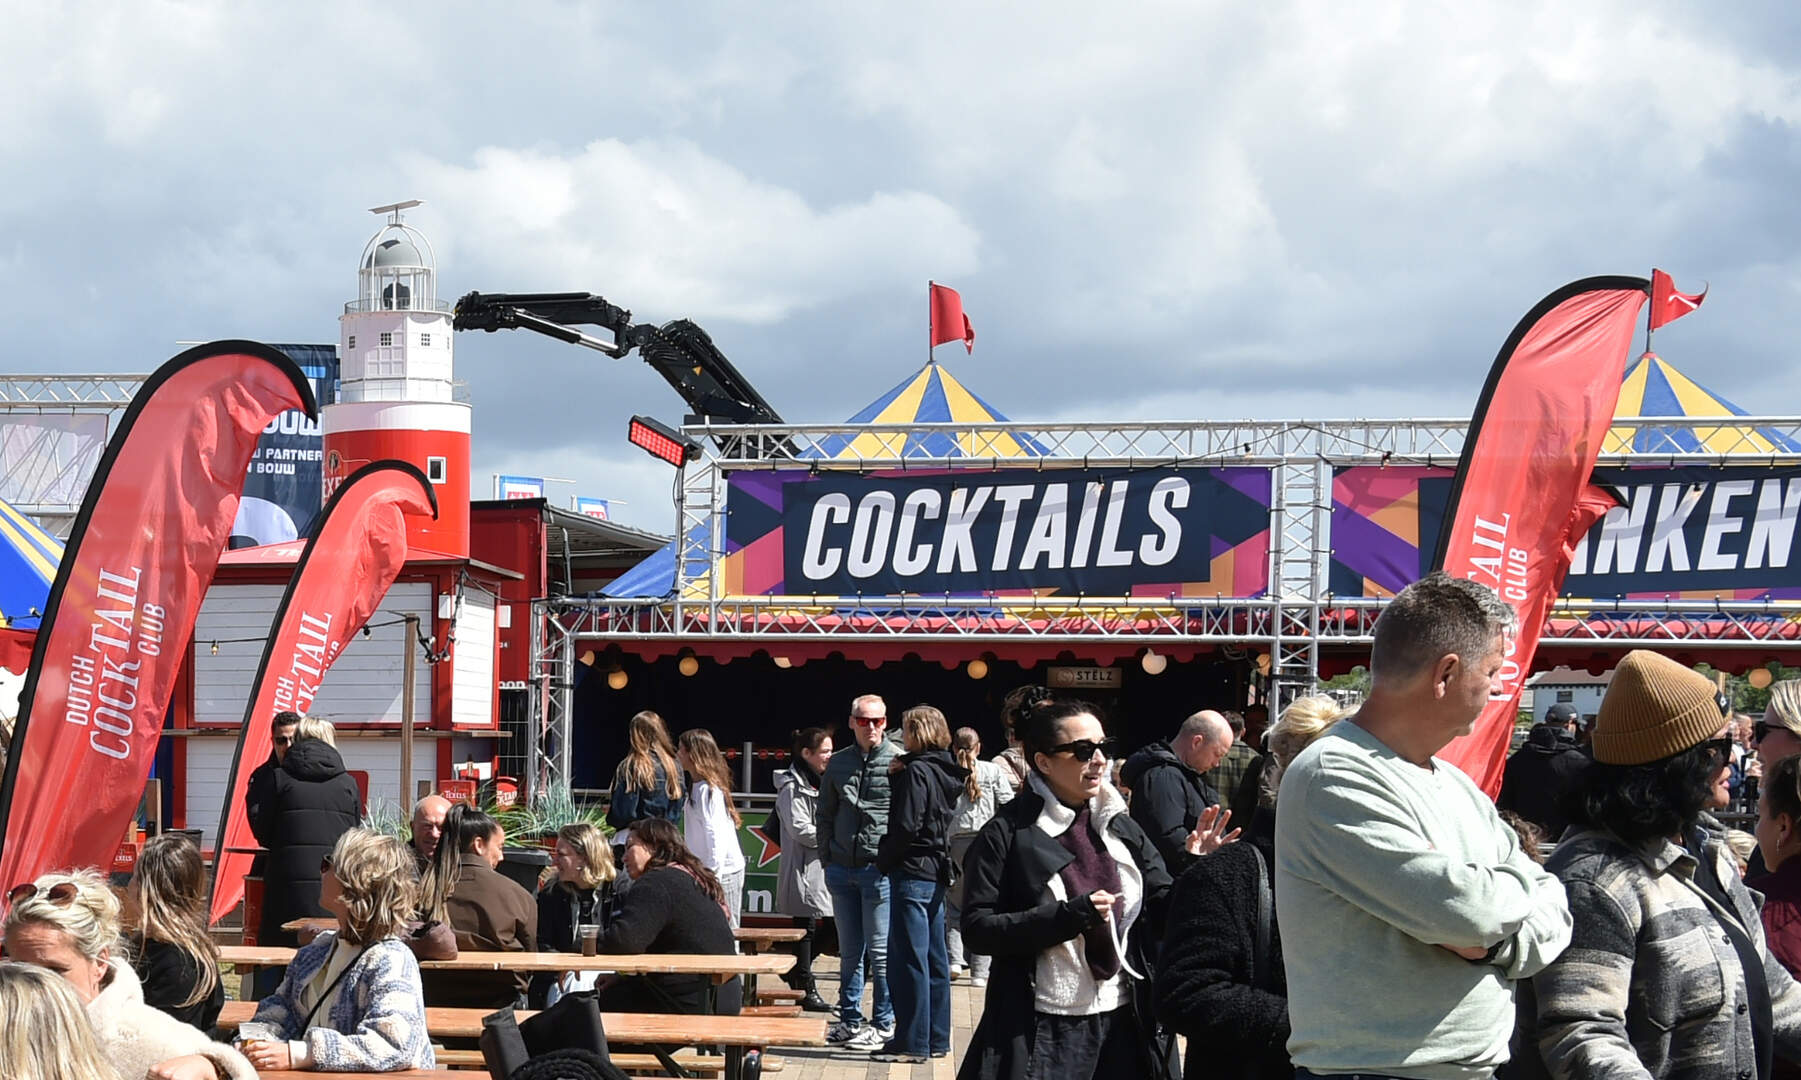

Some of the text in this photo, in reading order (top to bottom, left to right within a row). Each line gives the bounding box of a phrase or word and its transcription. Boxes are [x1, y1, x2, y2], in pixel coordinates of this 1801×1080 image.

[257, 463, 296, 475] BOUW
[265, 448, 323, 461] PARTNER
[802, 476, 1191, 580] COCKTAILS
[1505, 547, 1529, 600] CLUB
[137, 602, 166, 657] CLUB
[66, 655, 95, 726] DUTCH
